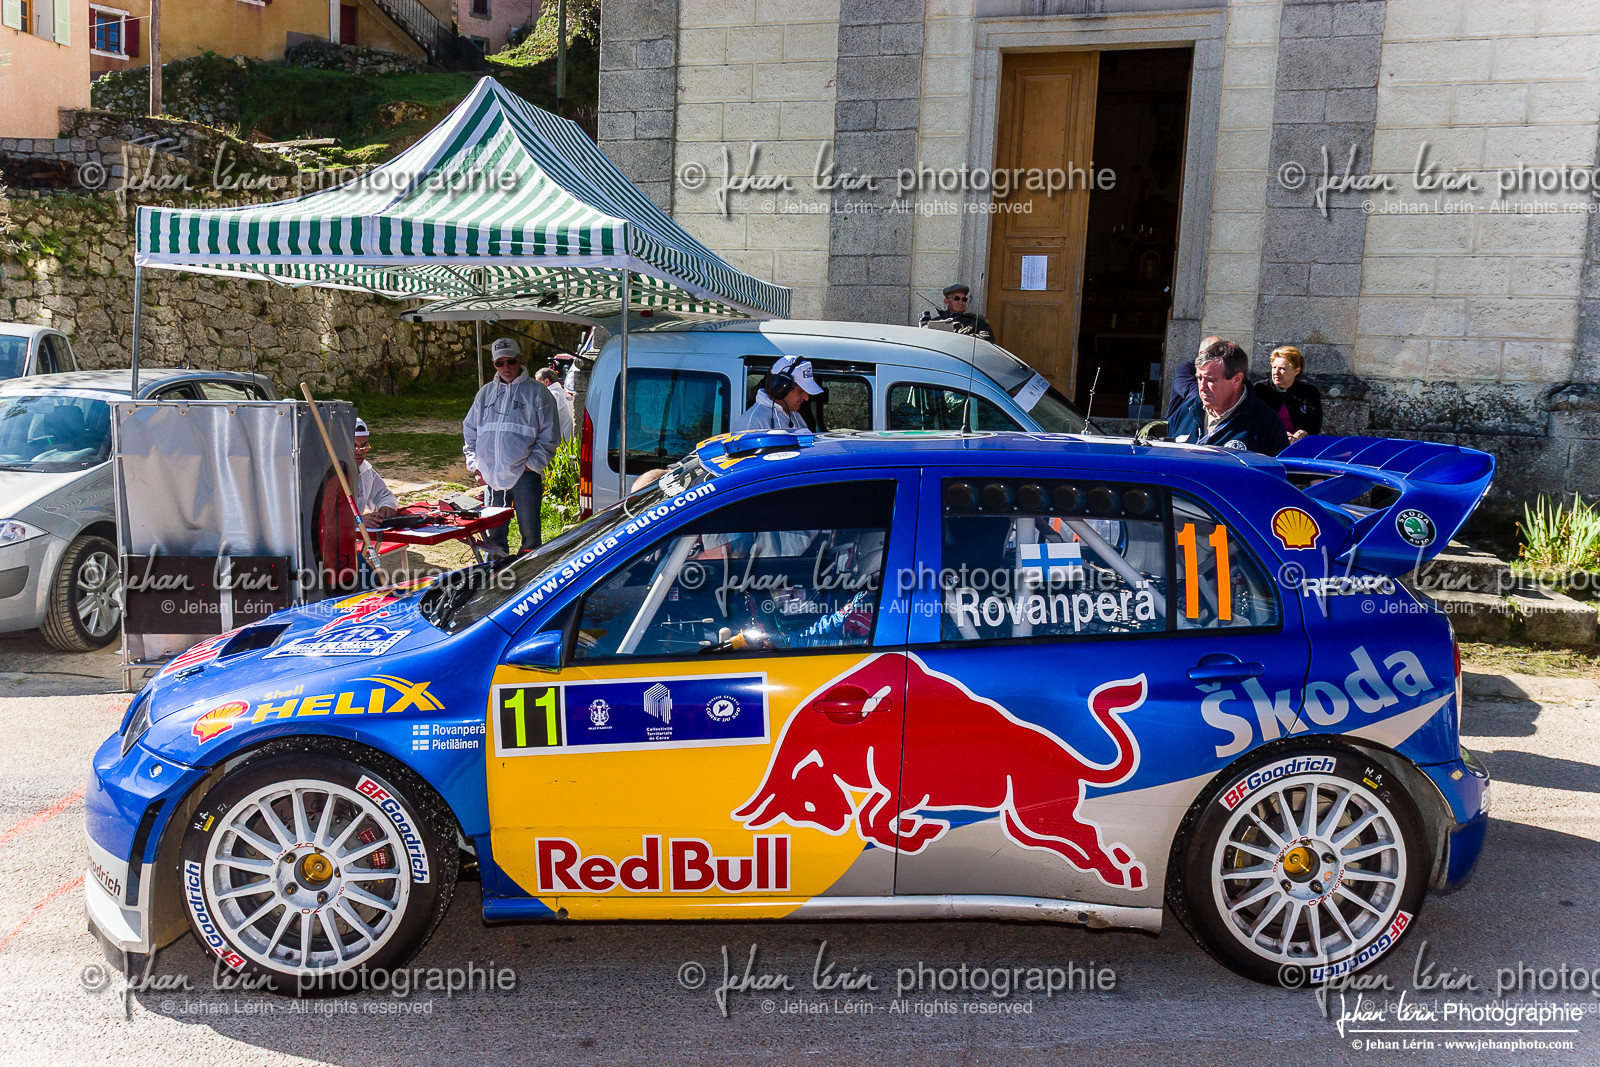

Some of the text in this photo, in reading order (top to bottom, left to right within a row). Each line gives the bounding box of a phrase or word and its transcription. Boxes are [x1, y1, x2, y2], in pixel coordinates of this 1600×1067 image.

[511, 480, 717, 618] www.skoda-auto.com
[1409, 537, 1430, 545] AUTO
[1176, 522, 1233, 620] 11
[1302, 577, 1397, 598] RECARO
[955, 579, 1157, 632] Rovanperä
[252, 676, 445, 724] HELIX
[262, 684, 304, 702] Shell
[504, 687, 559, 747] 11
[432, 723, 486, 737] Rovanperä
[432, 737, 480, 751] Pietiläinen
[1222, 757, 1336, 810] BFGoodrich
[536, 836, 790, 893] Red Bull
